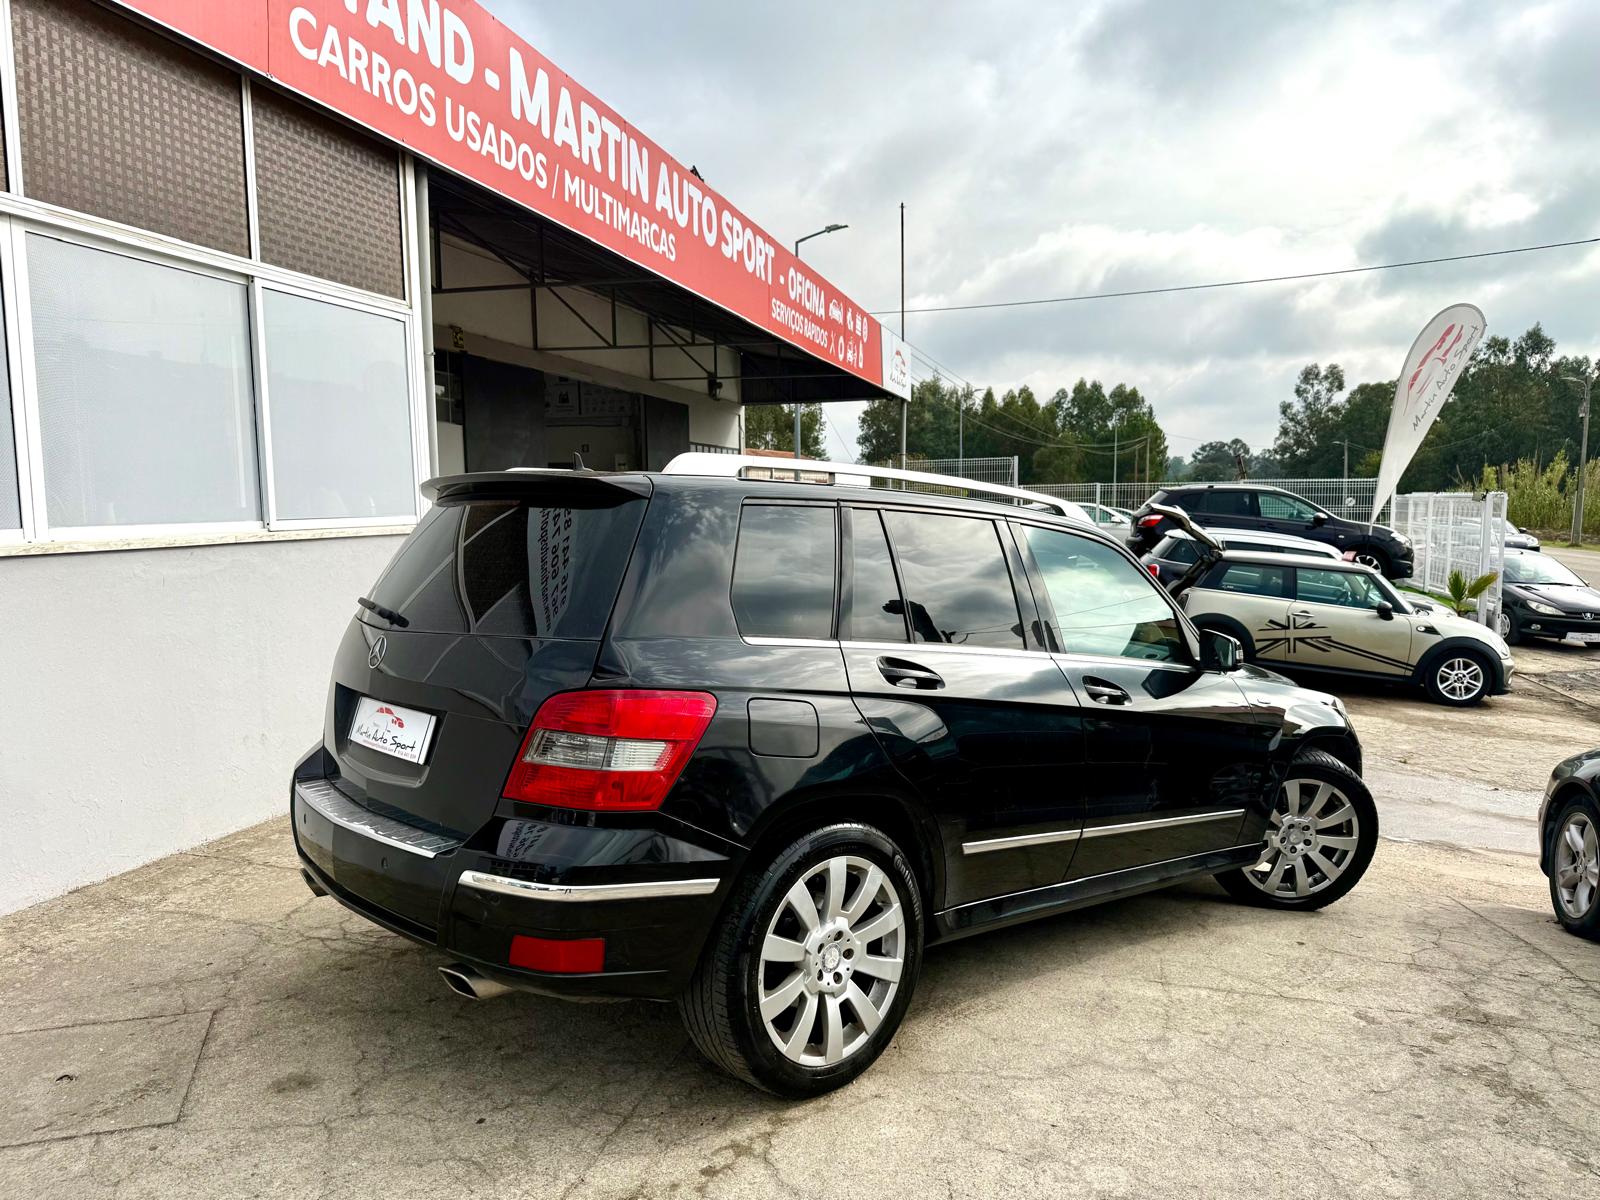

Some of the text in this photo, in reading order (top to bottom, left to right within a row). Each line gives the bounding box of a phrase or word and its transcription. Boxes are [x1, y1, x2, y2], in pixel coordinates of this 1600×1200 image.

[288, 6, 677, 263] CARROS USADOS / MULTIMARCAS
[345, 0, 475, 85] AND
[509, 46, 649, 205] MARTIN
[655, 161, 718, 247] AUTO
[721, 209, 775, 286] SPORT
[788, 266, 826, 320] OFICINA
[771, 297, 828, 348] SERVIÇOS RÁPIDOS
[1412, 324, 1479, 431] Martin Auto Sport
[371, 728, 388, 744] Auto
[389, 735, 417, 754] Sport
